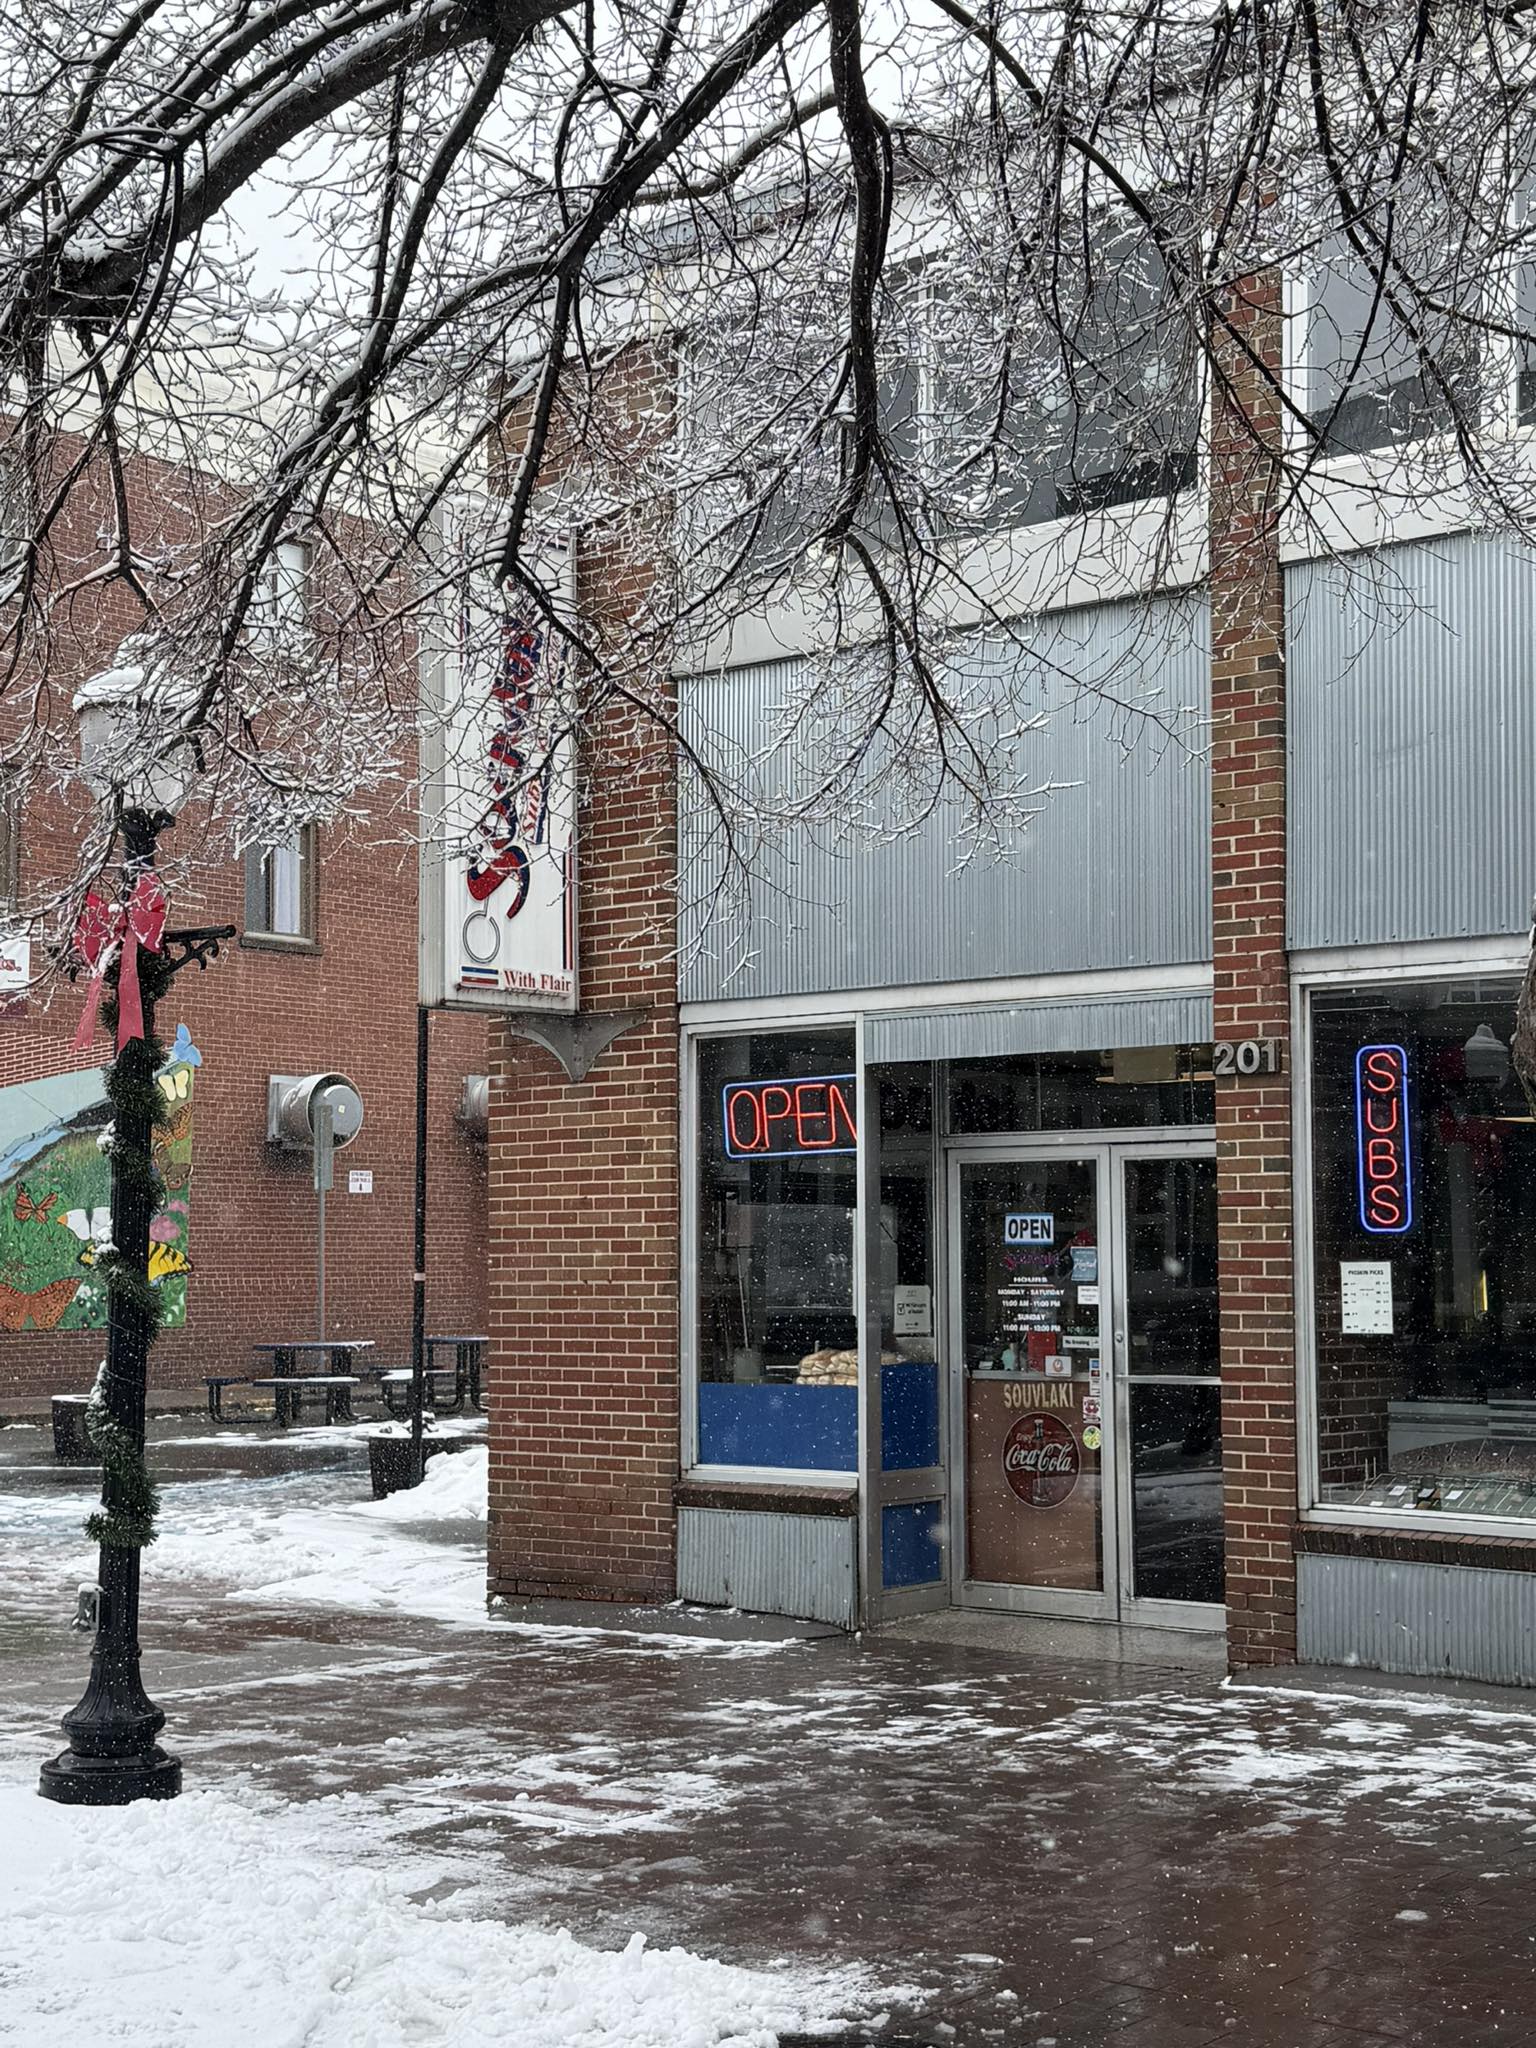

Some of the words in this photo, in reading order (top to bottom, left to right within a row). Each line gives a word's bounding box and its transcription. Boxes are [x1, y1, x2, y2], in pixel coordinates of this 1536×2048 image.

[503, 970, 536, 989] With
[540, 974, 573, 993] Flair
[1214, 1039, 1276, 1075] 201
[729, 1083, 858, 1149] OPEN
[1366, 1052, 1400, 1225] SUBS
[1007, 1218, 1051, 1240] OPEN
[1016, 1313, 1046, 1321] SUNDAY
[1003, 1382, 1076, 1409] SOUVLAKI
